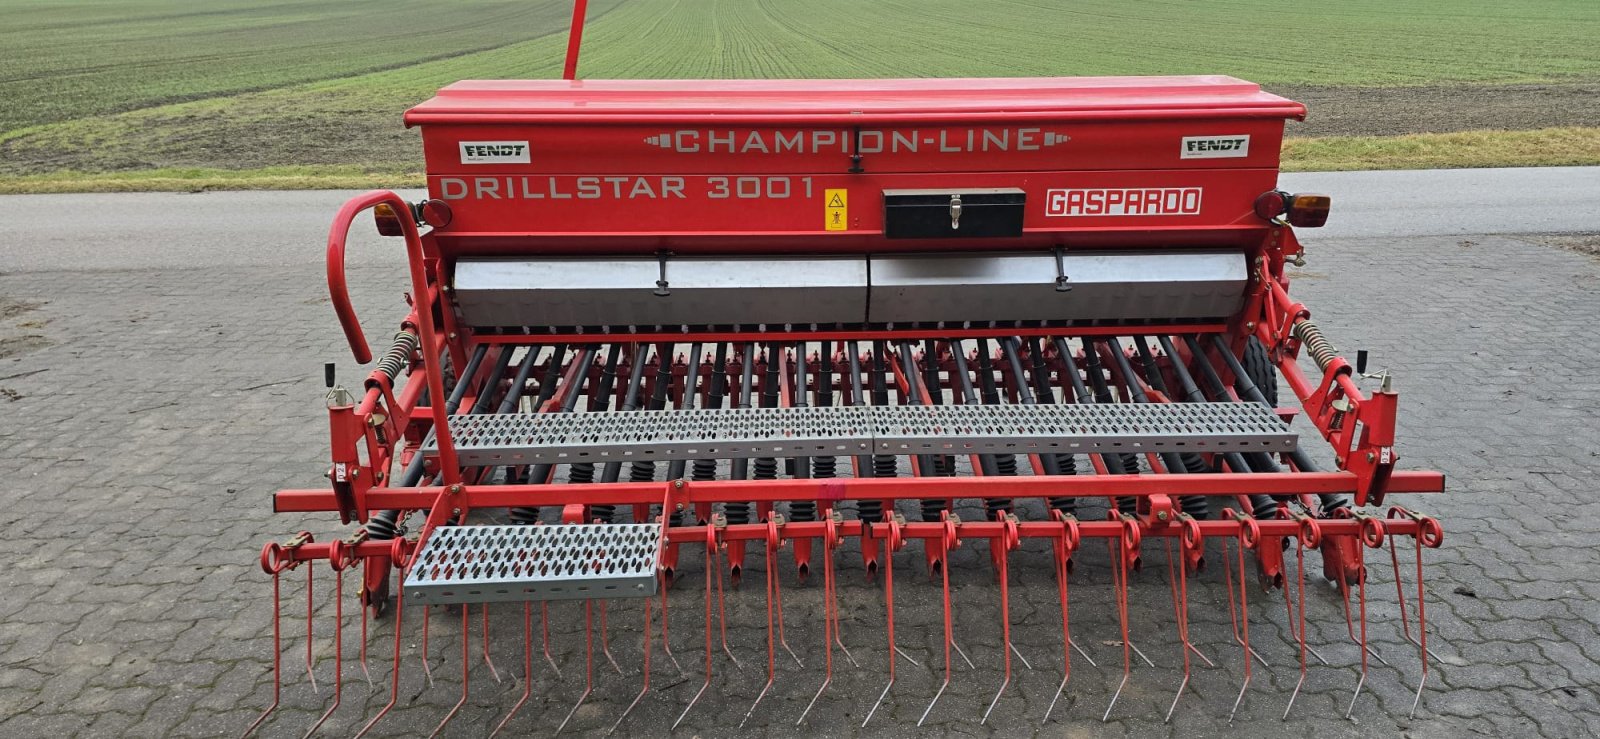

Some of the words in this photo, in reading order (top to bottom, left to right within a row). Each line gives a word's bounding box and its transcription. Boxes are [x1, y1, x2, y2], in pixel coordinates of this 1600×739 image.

[464, 145, 525, 157] FENDT
[674, 128, 1040, 153] CHAMPION-LINE
[1186, 139, 1246, 152] FENDT
[440, 176, 687, 200] DRILLSTAR
[707, 176, 812, 199] 3001
[1047, 188, 1200, 215] GASPARDO
